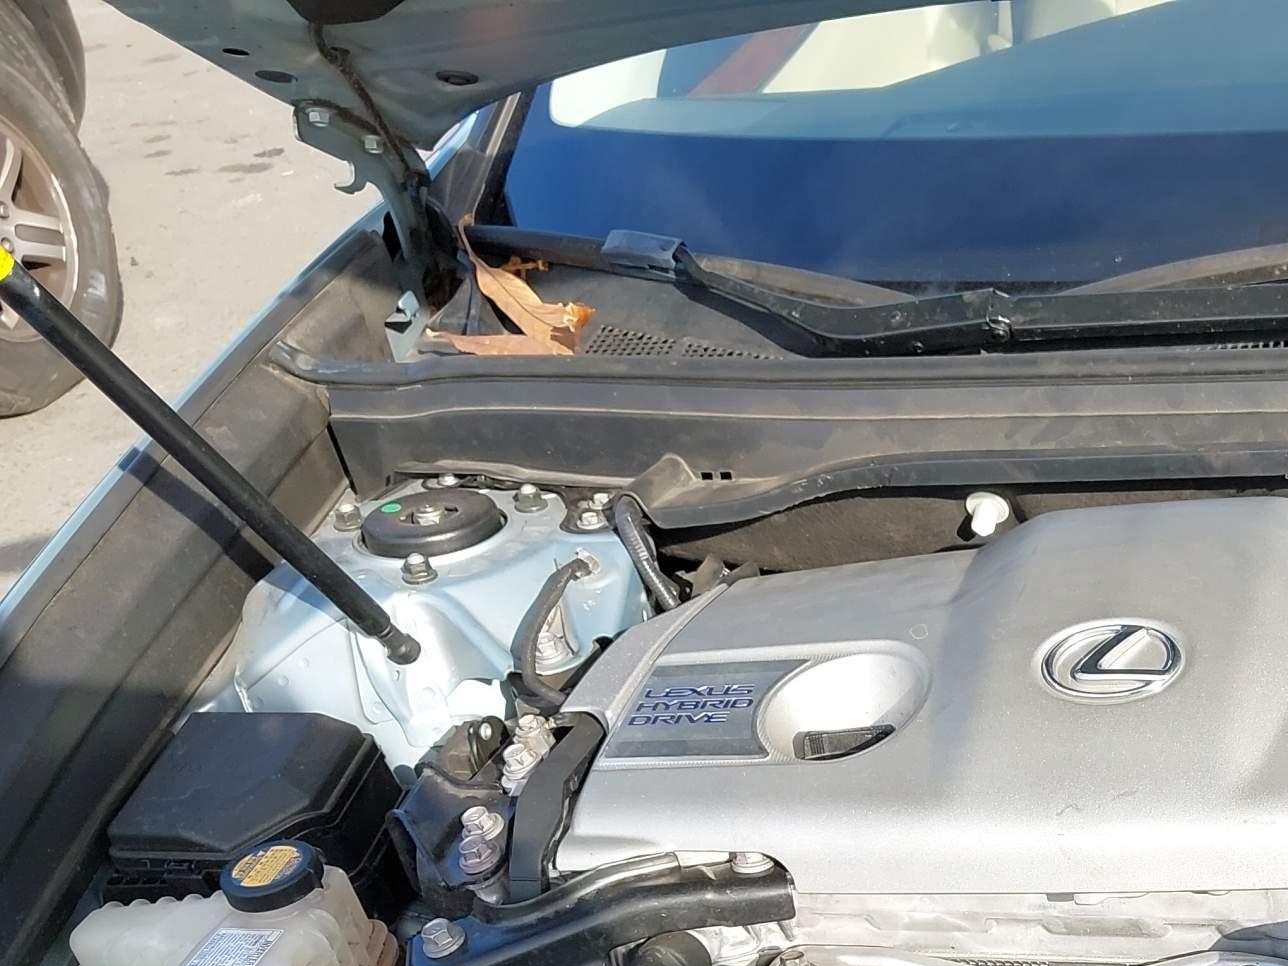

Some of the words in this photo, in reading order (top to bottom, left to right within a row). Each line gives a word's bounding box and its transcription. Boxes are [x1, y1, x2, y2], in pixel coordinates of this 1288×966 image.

[644, 683, 755, 699] LEXUS
[636, 697, 754, 712] HYBRID
[627, 710, 732, 726] DRIVE
